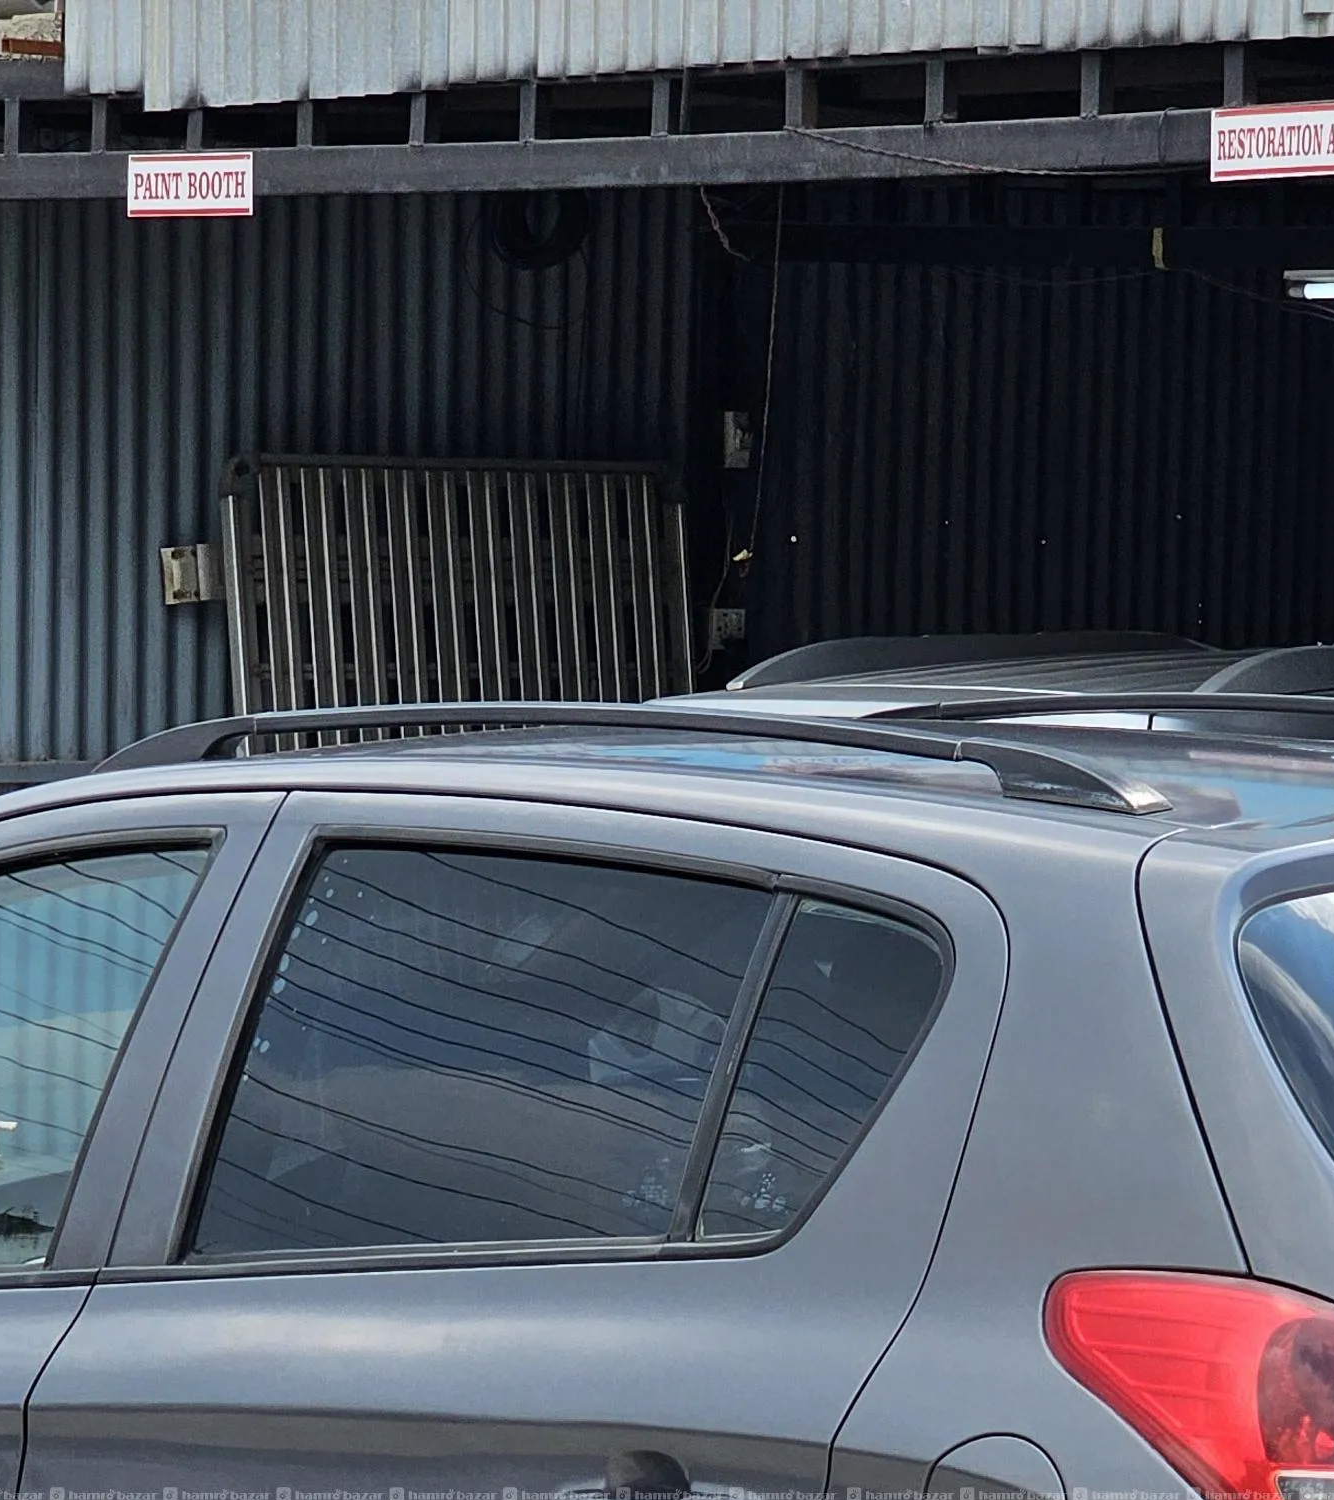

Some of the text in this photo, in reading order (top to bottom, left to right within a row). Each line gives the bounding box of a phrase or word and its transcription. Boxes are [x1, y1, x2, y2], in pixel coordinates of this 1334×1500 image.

[1218, 124, 1323, 161] RESTORATION
[134, 171, 246, 200] PAINT BOOTH
